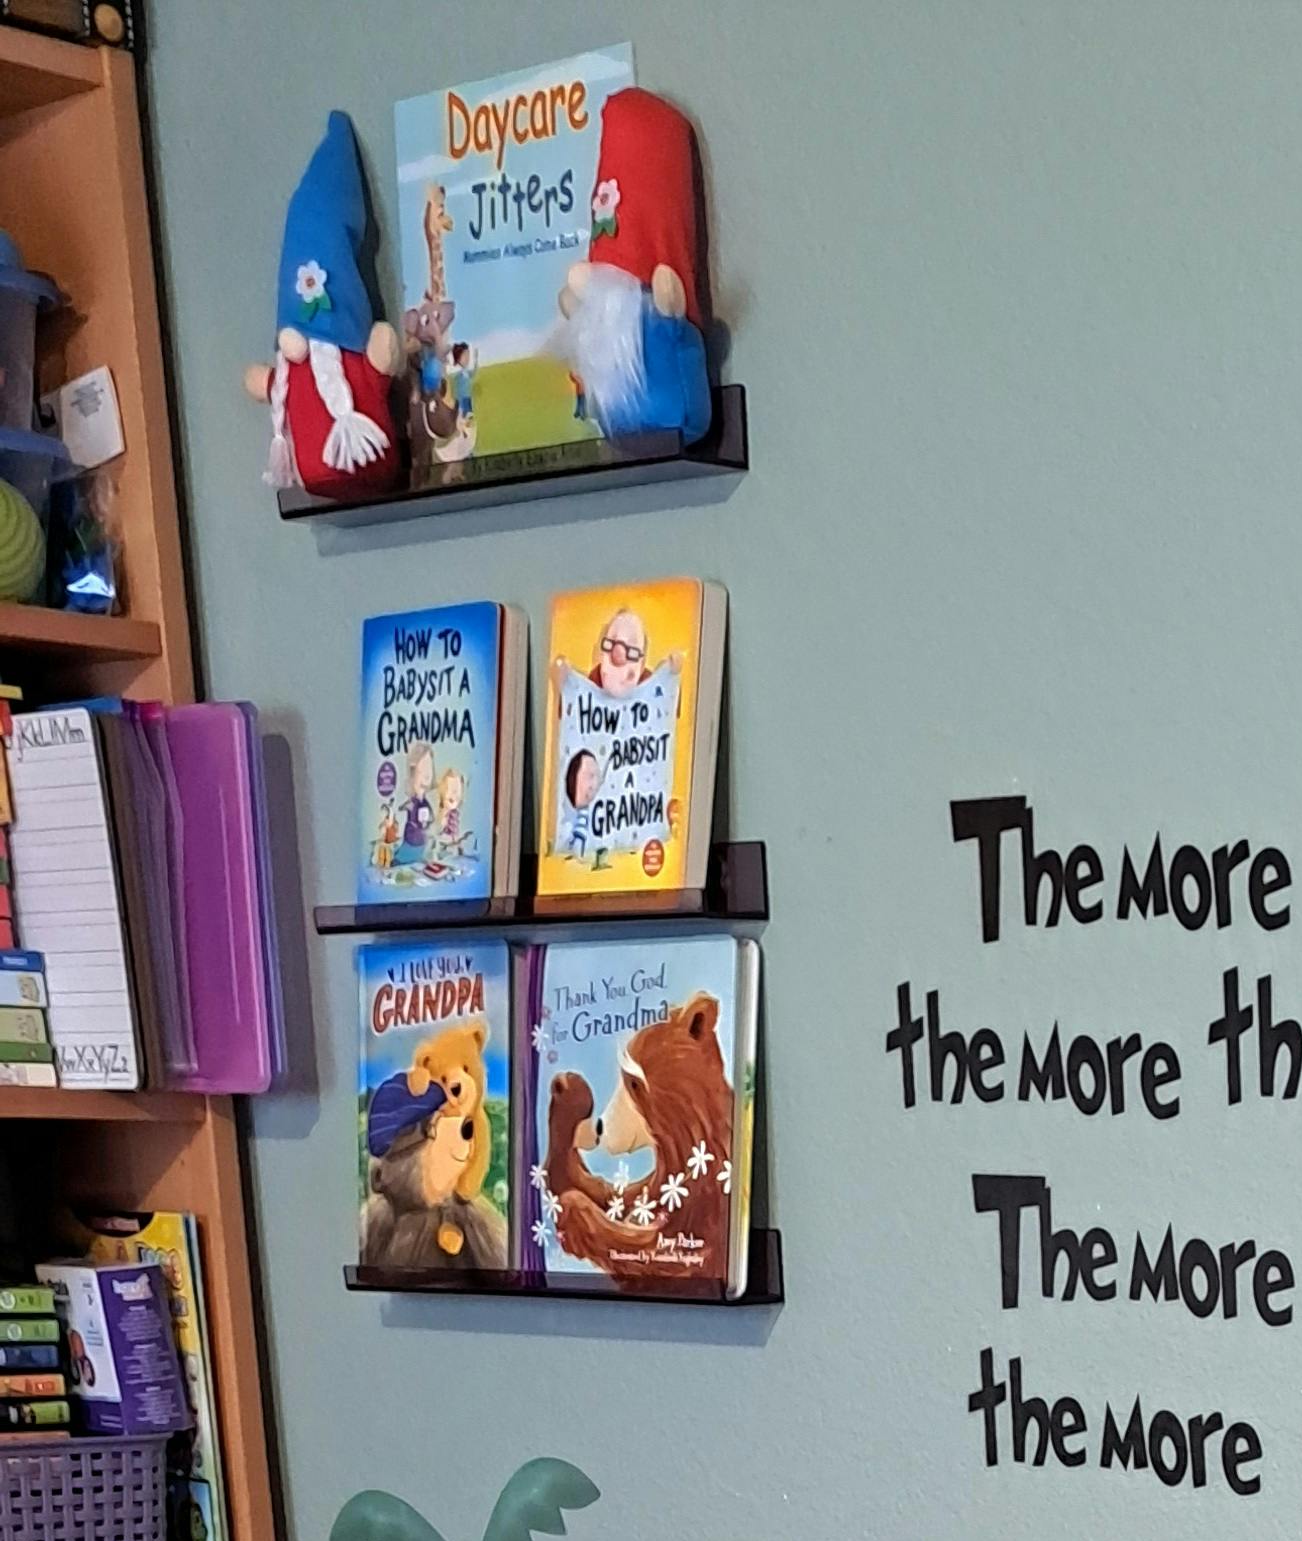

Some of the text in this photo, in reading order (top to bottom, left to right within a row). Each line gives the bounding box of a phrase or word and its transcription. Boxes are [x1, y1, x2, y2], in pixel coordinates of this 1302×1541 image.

[448, 81, 588, 170] Daycare
[469, 169, 573, 240] Jitters
[394, 627, 463, 664] HOW TO
[383, 666, 472, 709] BABYSIT A
[377, 708, 475, 757] GRANDMA
[578, 692, 648, 734] HOW TO
[611, 734, 670, 770] BABYSIT
[625, 771, 634, 788] A
[591, 792, 664, 838] GRANDPA
[950, 796, 1103, 943] The
[372, 972, 485, 1034] GRANDPA
[555, 964, 667, 1012] Thank You God
[572, 998, 670, 1042] Grandma
[886, 982, 1004, 1108] the
[972, 1174, 1117, 1309] The
[969, 1348, 1087, 1467] the
